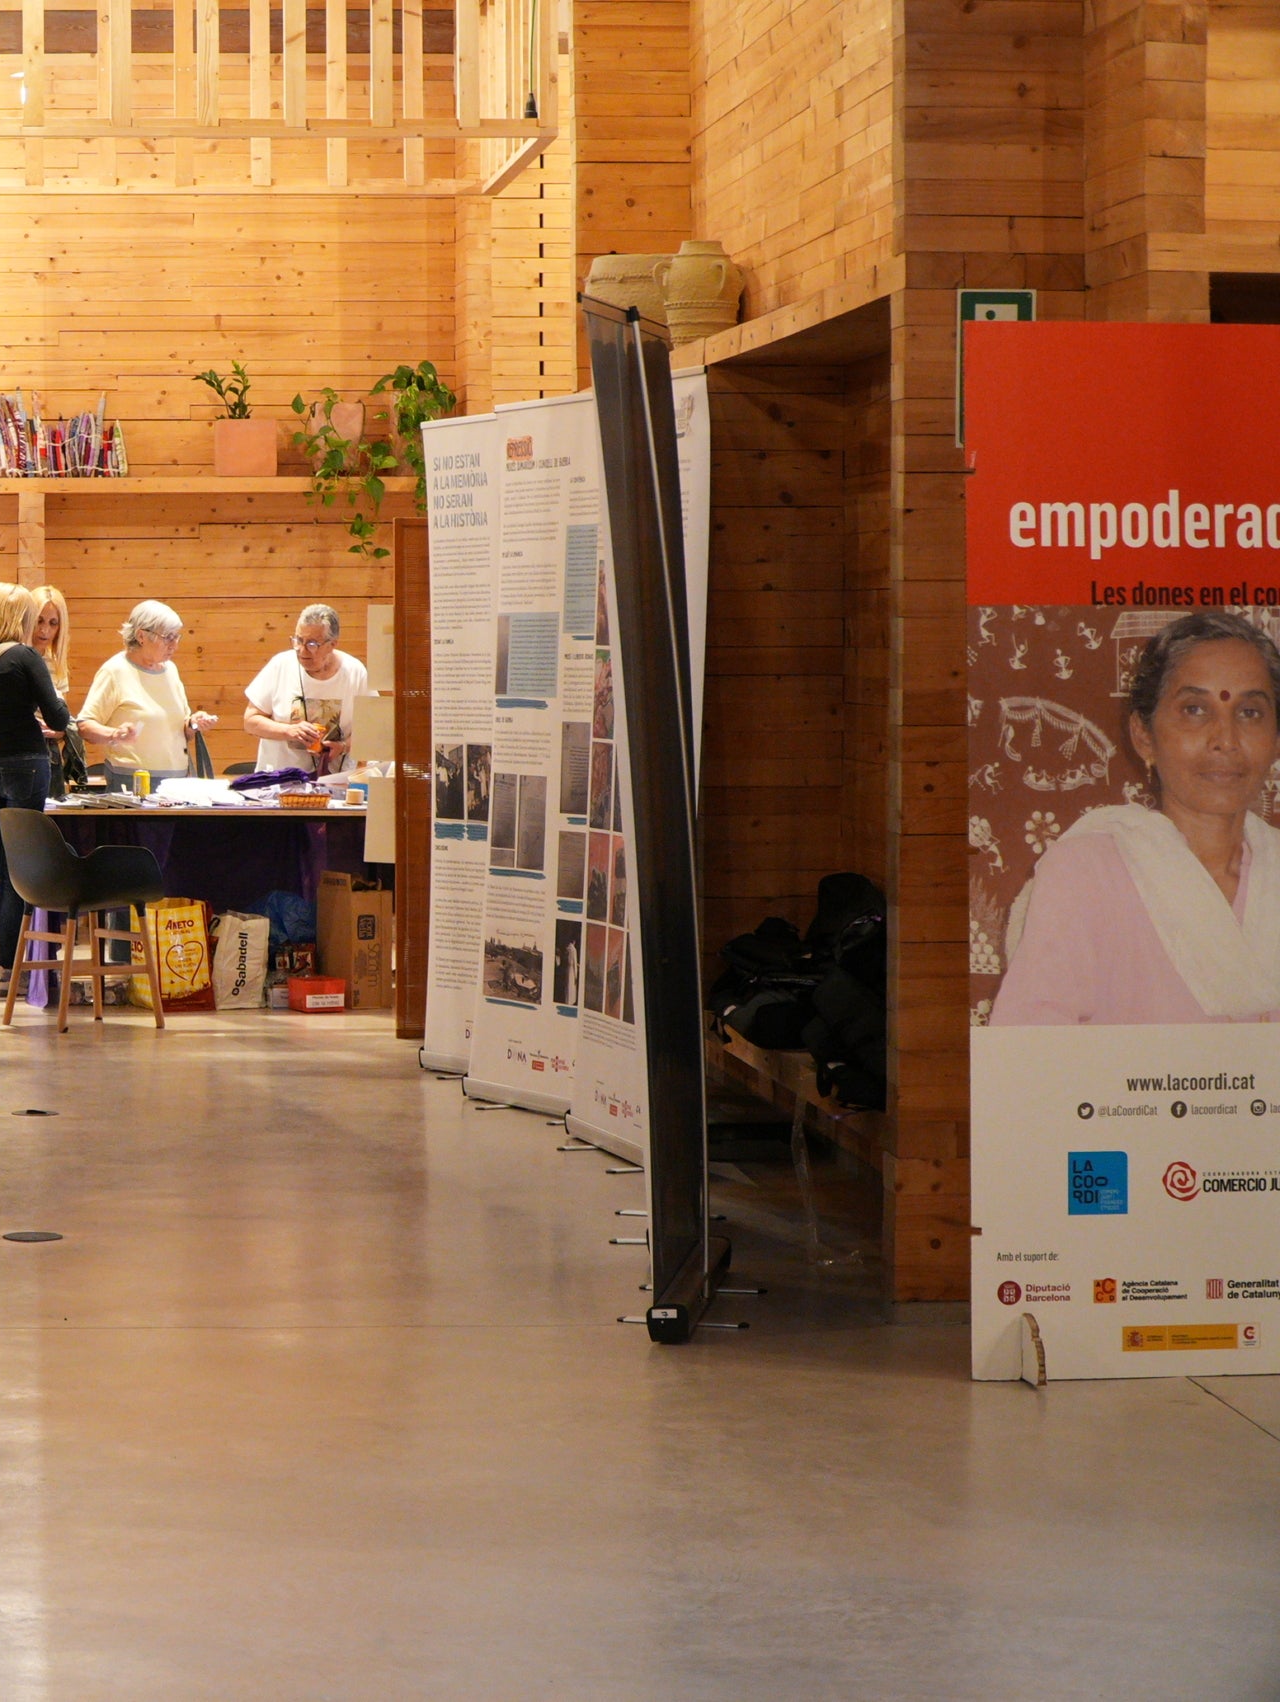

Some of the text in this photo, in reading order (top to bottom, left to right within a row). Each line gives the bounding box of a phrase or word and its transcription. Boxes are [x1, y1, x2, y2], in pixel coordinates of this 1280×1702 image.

[433, 453, 481, 472] SI NO ESTAN
[433, 469, 488, 490] A LA MEMÒRIA
[433, 493, 473, 510] NO SERAN
[433, 508, 488, 529] A LA HISTÒRIA
[1091, 581, 1280, 606] Les dones en el co
[165, 919, 195, 931] ANETO
[1126, 1072, 1256, 1092] www.lacoordi.cat
[1098, 1104, 1158, 1117] @LaCoordiCat
[1191, 1103, 1238, 1116] lacoordicat
[1073, 1159, 1094, 1174] LA
[1072, 1175, 1108, 1189] COO
[1203, 1178, 1267, 1192] COMERCIO
[1073, 1190, 1099, 1204] RDI
[997, 1252, 1060, 1263] Amb el suport de:
[1025, 1283, 1071, 1294] Diputació
[1227, 1279, 1279, 1289] Generalitat
[1025, 1294, 1071, 1302] Barcelona
[1227, 1290, 1239, 1299] de
